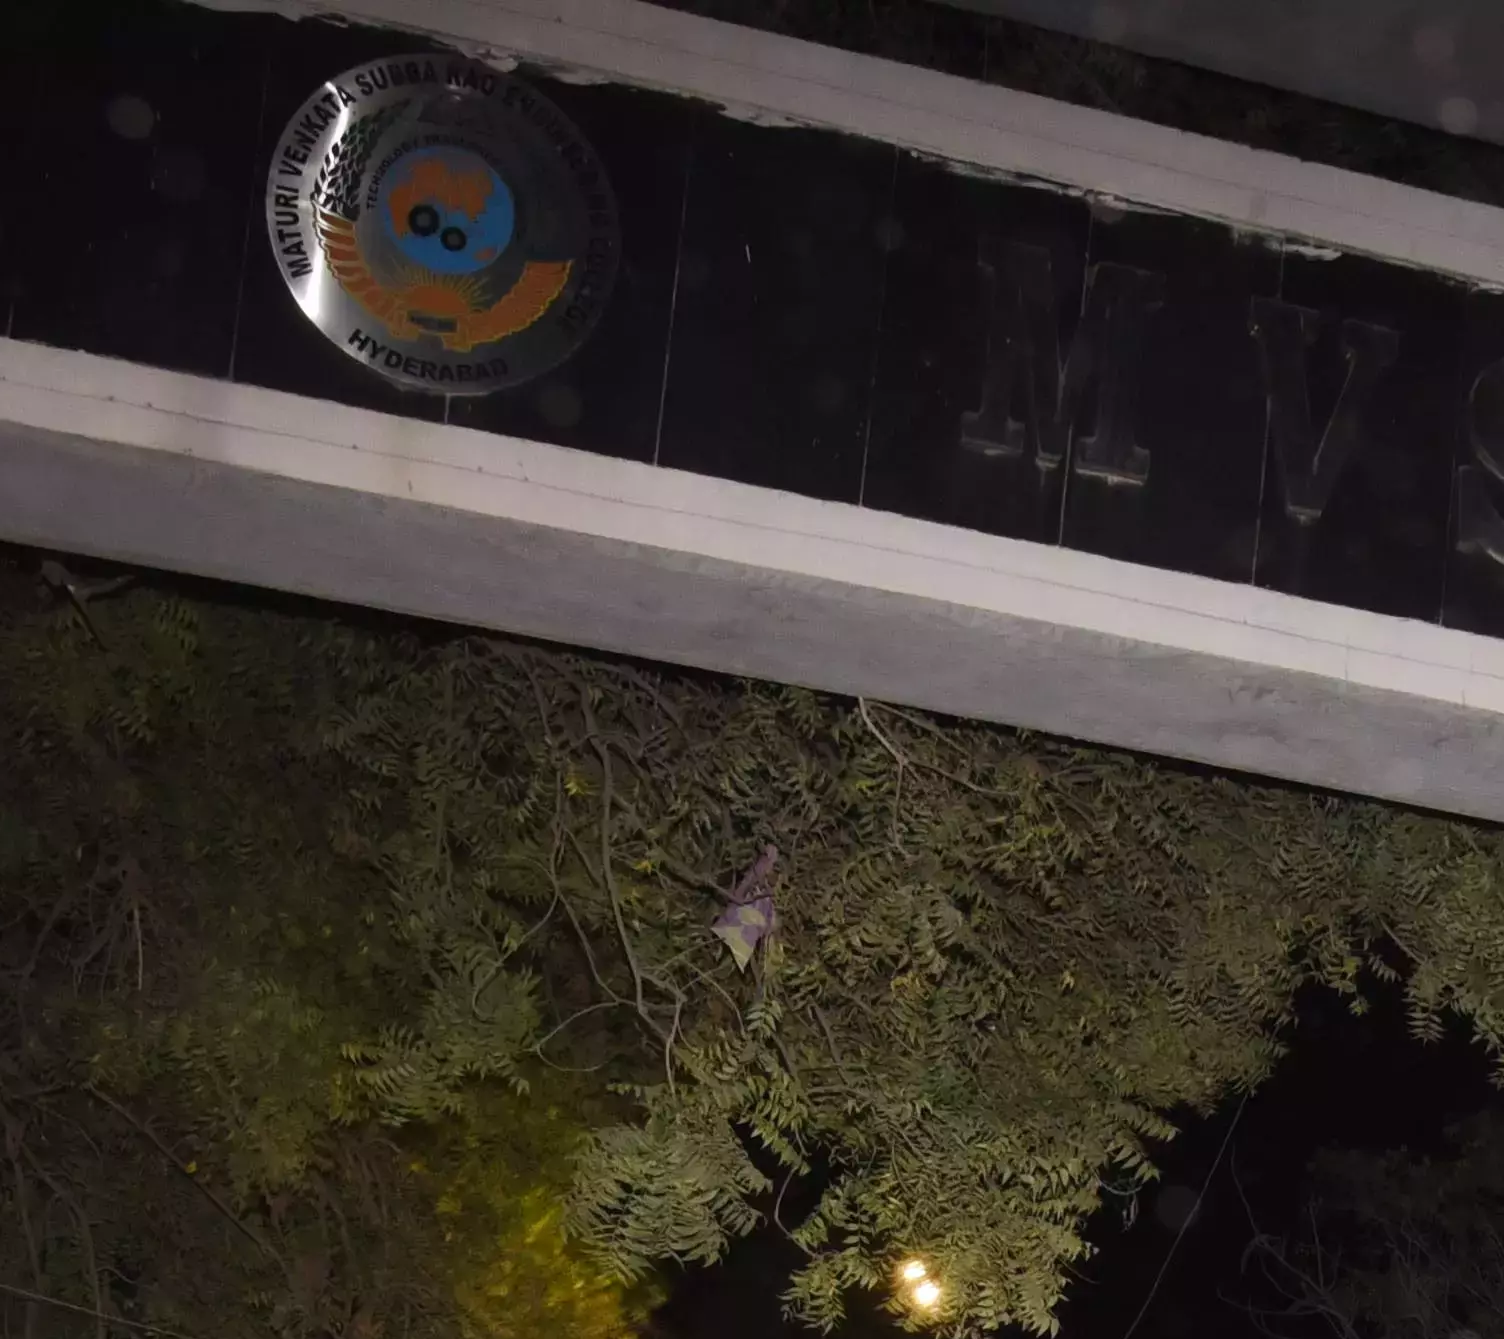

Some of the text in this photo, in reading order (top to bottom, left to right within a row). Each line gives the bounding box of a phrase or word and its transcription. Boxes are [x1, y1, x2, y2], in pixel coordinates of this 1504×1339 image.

[279, 86, 356, 180] VENKATA
[275, 181, 314, 279] MATURI
[348, 328, 508, 382] HYDERABAD
